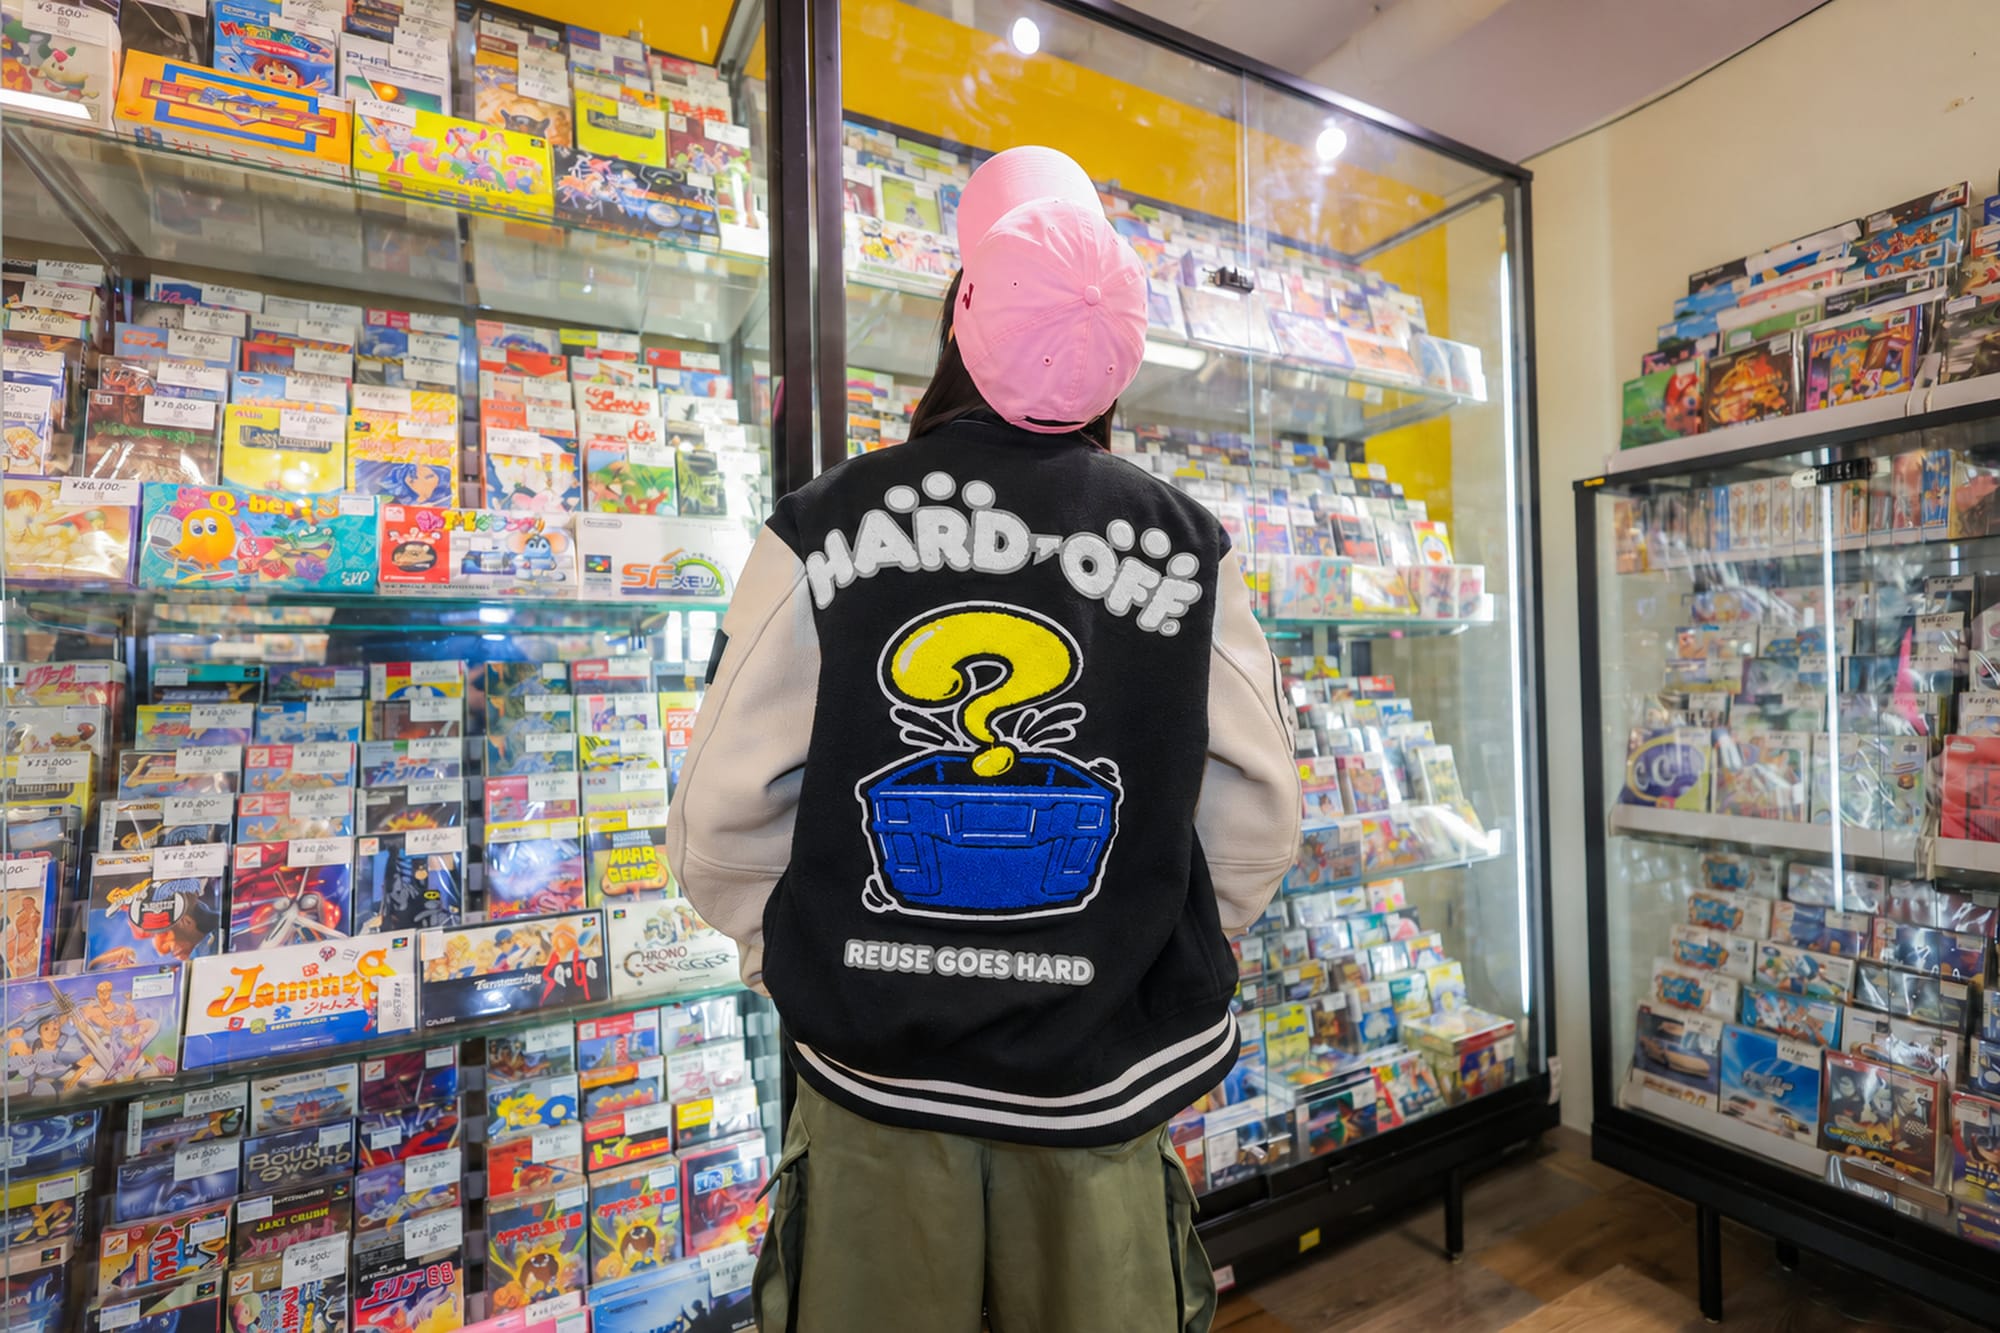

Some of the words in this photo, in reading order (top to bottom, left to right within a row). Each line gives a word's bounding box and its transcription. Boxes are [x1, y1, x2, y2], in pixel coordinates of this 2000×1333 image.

[846, 940, 933, 971] REUSE
[935, 947, 1011, 979] GOES
[1016, 955, 1094, 984] HARD
[259, 1151, 351, 1182] SWORD
